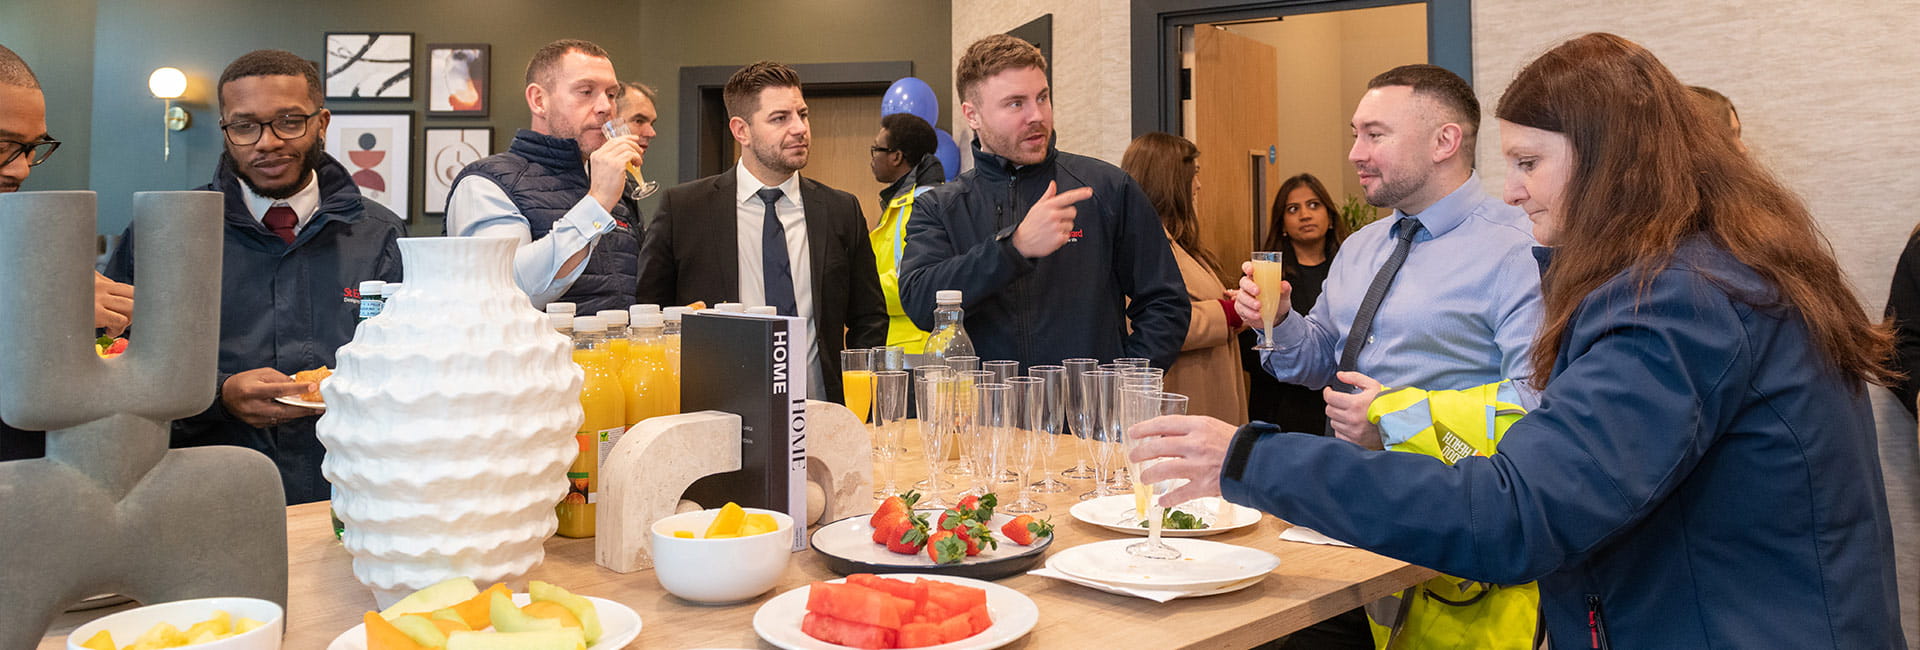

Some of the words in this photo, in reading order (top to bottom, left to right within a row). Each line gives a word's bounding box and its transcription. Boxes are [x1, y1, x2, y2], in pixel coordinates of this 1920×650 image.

[773, 331, 787, 395] HOME
[792, 399, 806, 471] HOME
[1441, 431, 1473, 459] HEALTH
